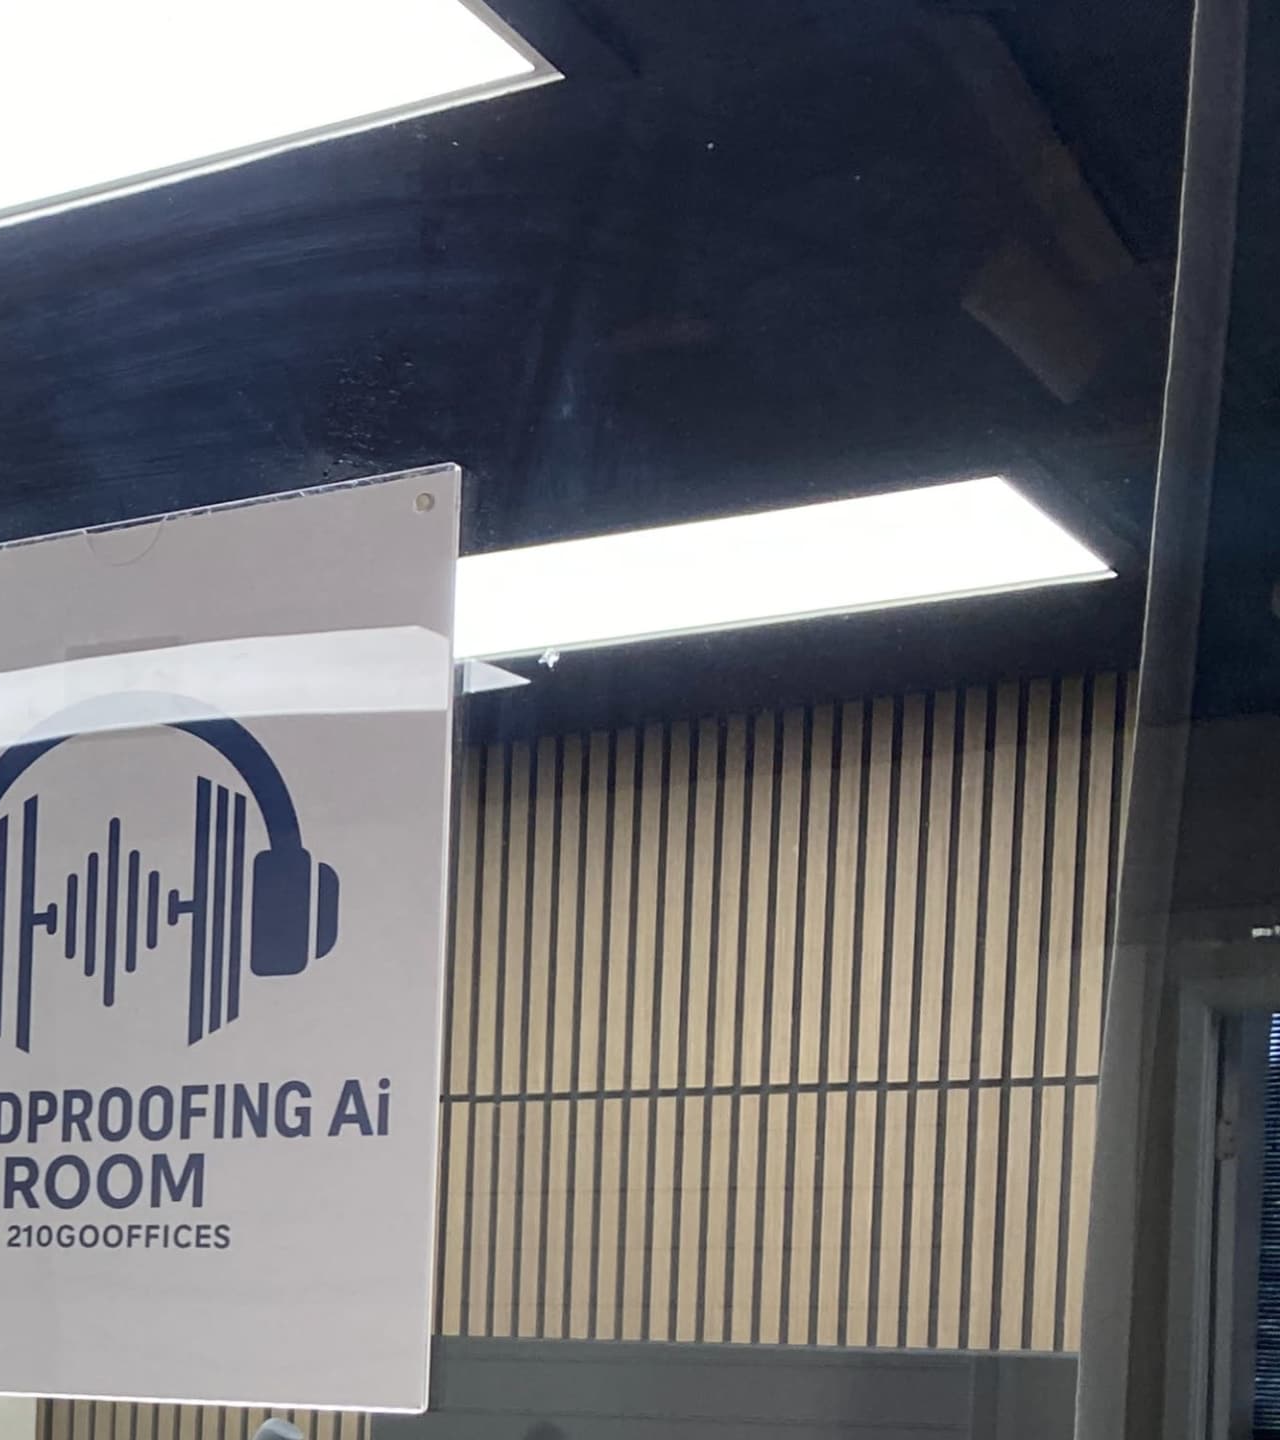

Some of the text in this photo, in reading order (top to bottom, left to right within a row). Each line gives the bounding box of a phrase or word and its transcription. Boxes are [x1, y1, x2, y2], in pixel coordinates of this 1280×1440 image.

[327, 1077, 391, 1137] Ai
[3, 1153, 205, 1210] ROOM
[6, 1223, 231, 1249] 210GOOFFICES
